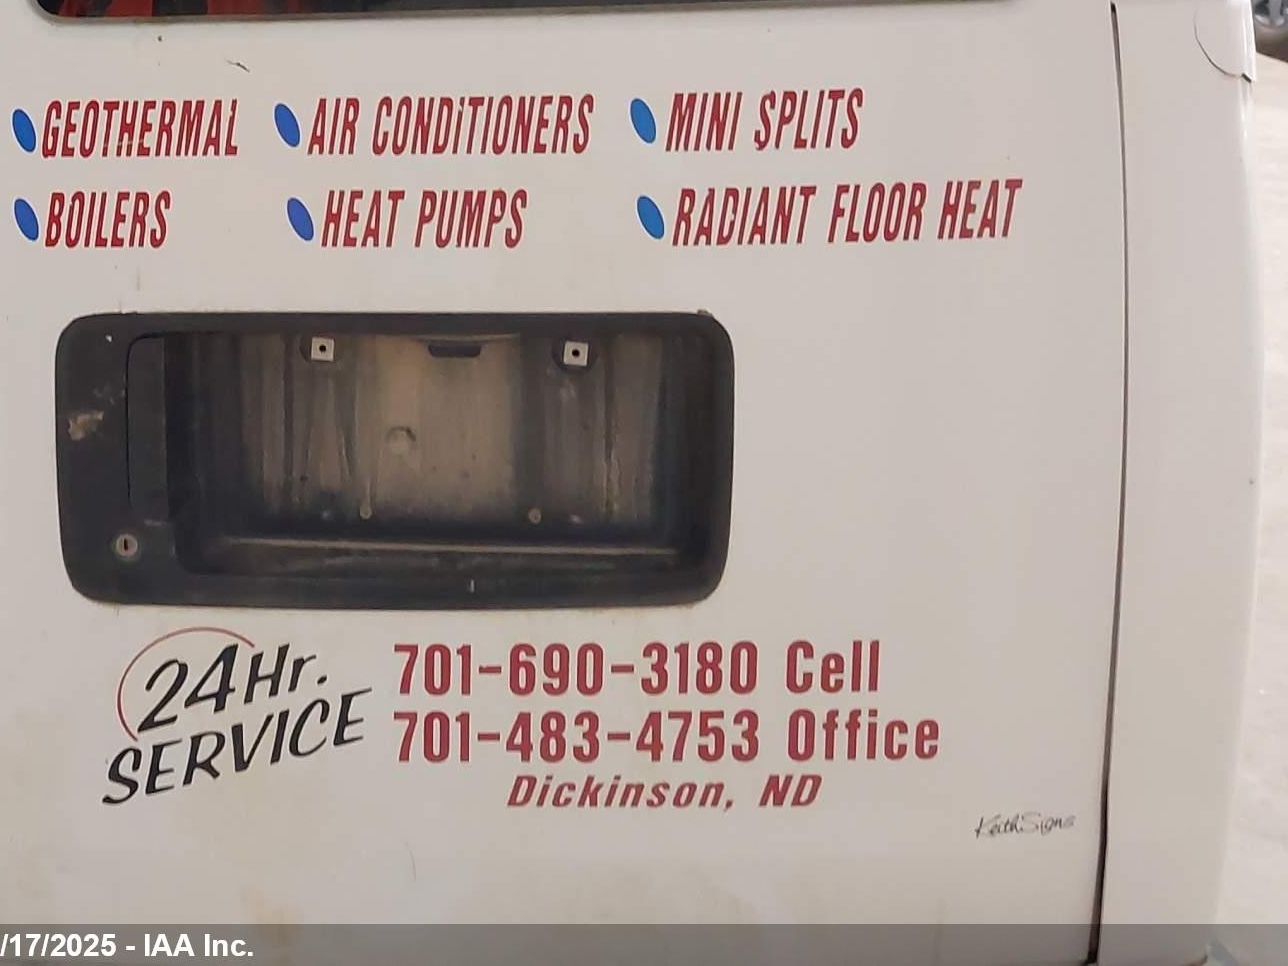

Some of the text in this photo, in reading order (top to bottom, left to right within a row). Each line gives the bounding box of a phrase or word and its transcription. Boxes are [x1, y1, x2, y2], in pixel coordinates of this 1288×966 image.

[41, 99, 238, 158] GEOTHERMAL
[308, 97, 359, 155] AIR
[665, 88, 864, 152] MINI SPLITS
[45, 191, 171, 248] BOILERS
[321, 189, 527, 248] HEAT PUMPS
[672, 179, 1023, 246] RADIANT FLOOR HEAT
[394, 640, 880, 696] 701-690-3180 Cell
[102, 688, 372, 805] SERVICE
[394, 708, 940, 762] 701-483-4753 Office
[506, 774, 823, 811] Dickinson, ND
